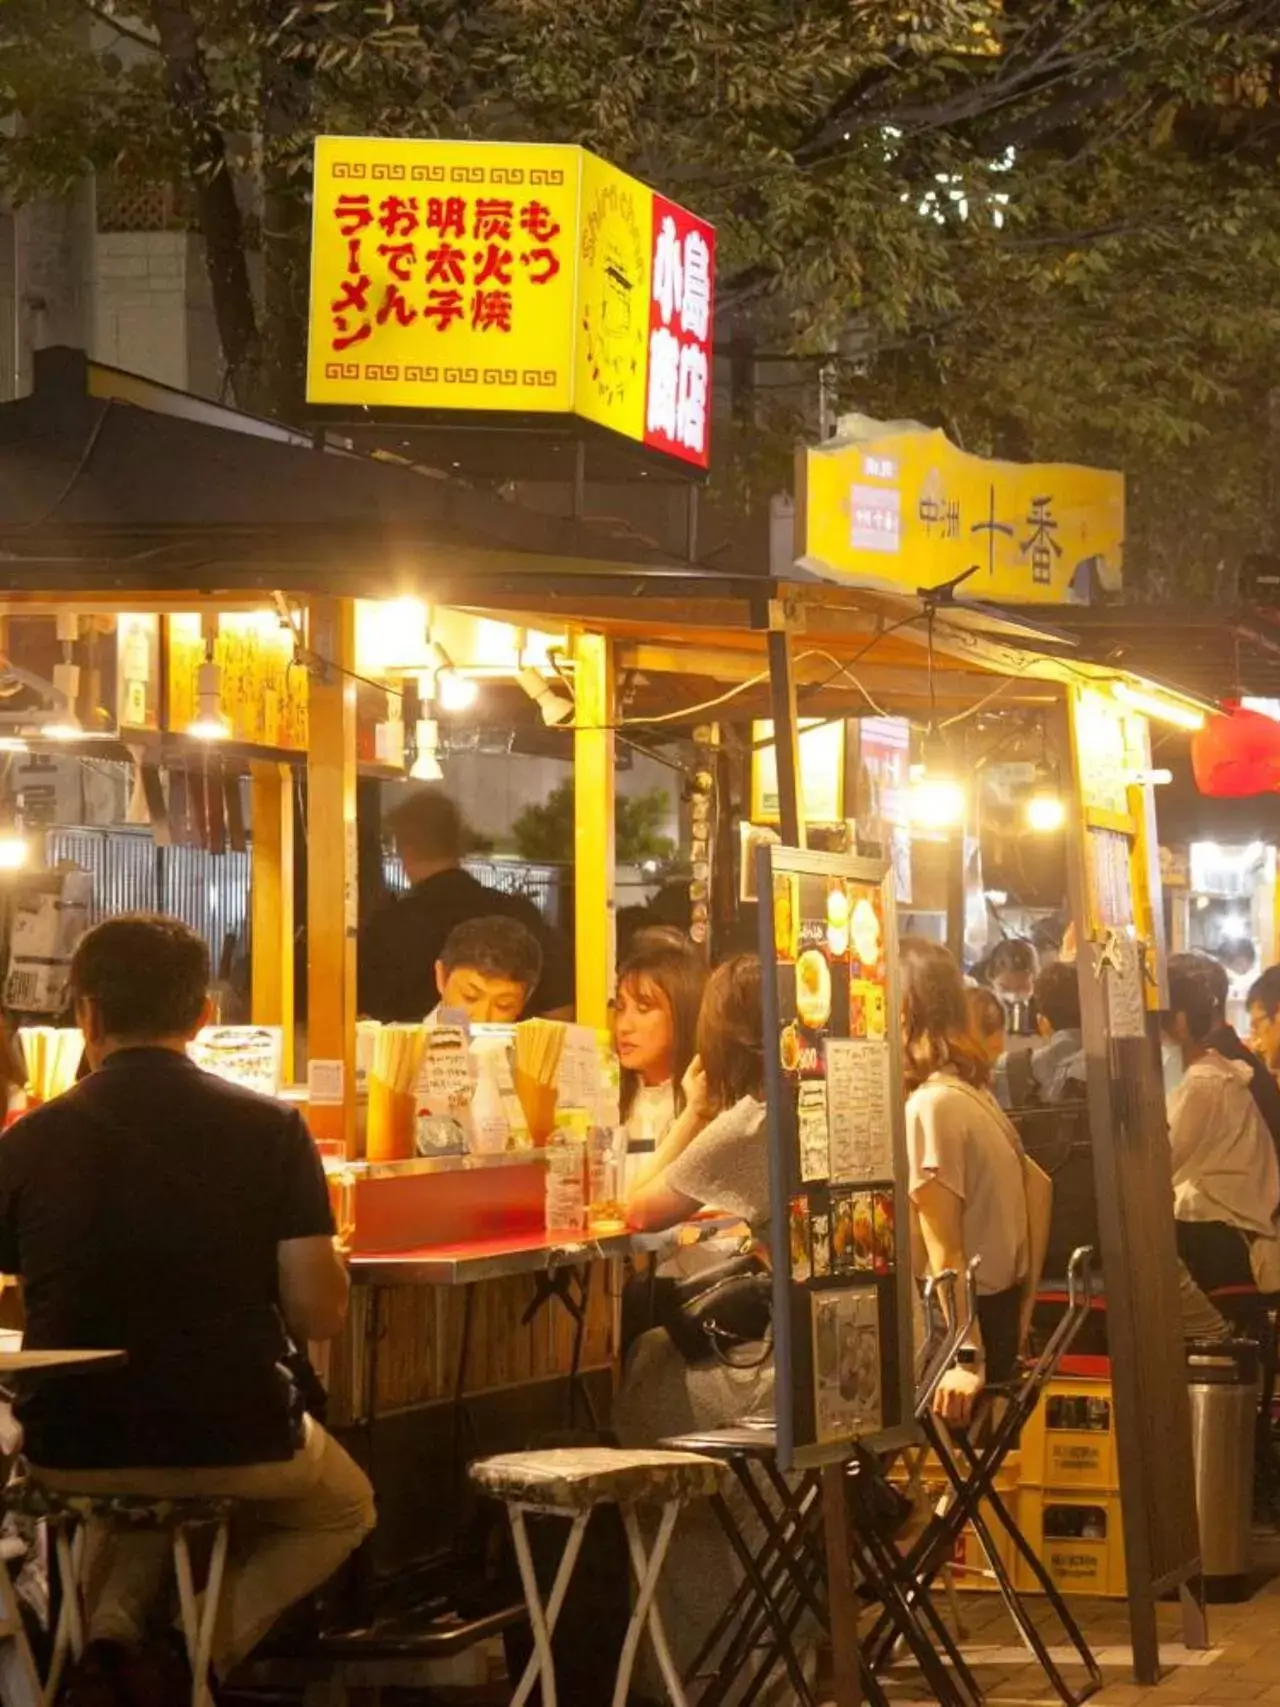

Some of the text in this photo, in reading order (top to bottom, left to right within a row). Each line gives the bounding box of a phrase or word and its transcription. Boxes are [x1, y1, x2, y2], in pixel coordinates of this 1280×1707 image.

[332, 194, 374, 352] ラーメン
[376, 195, 420, 327] おでん
[423, 197, 467, 332] 明太子
[470, 198, 513, 333] 炭火焼
[520, 200, 561, 285] もつ
